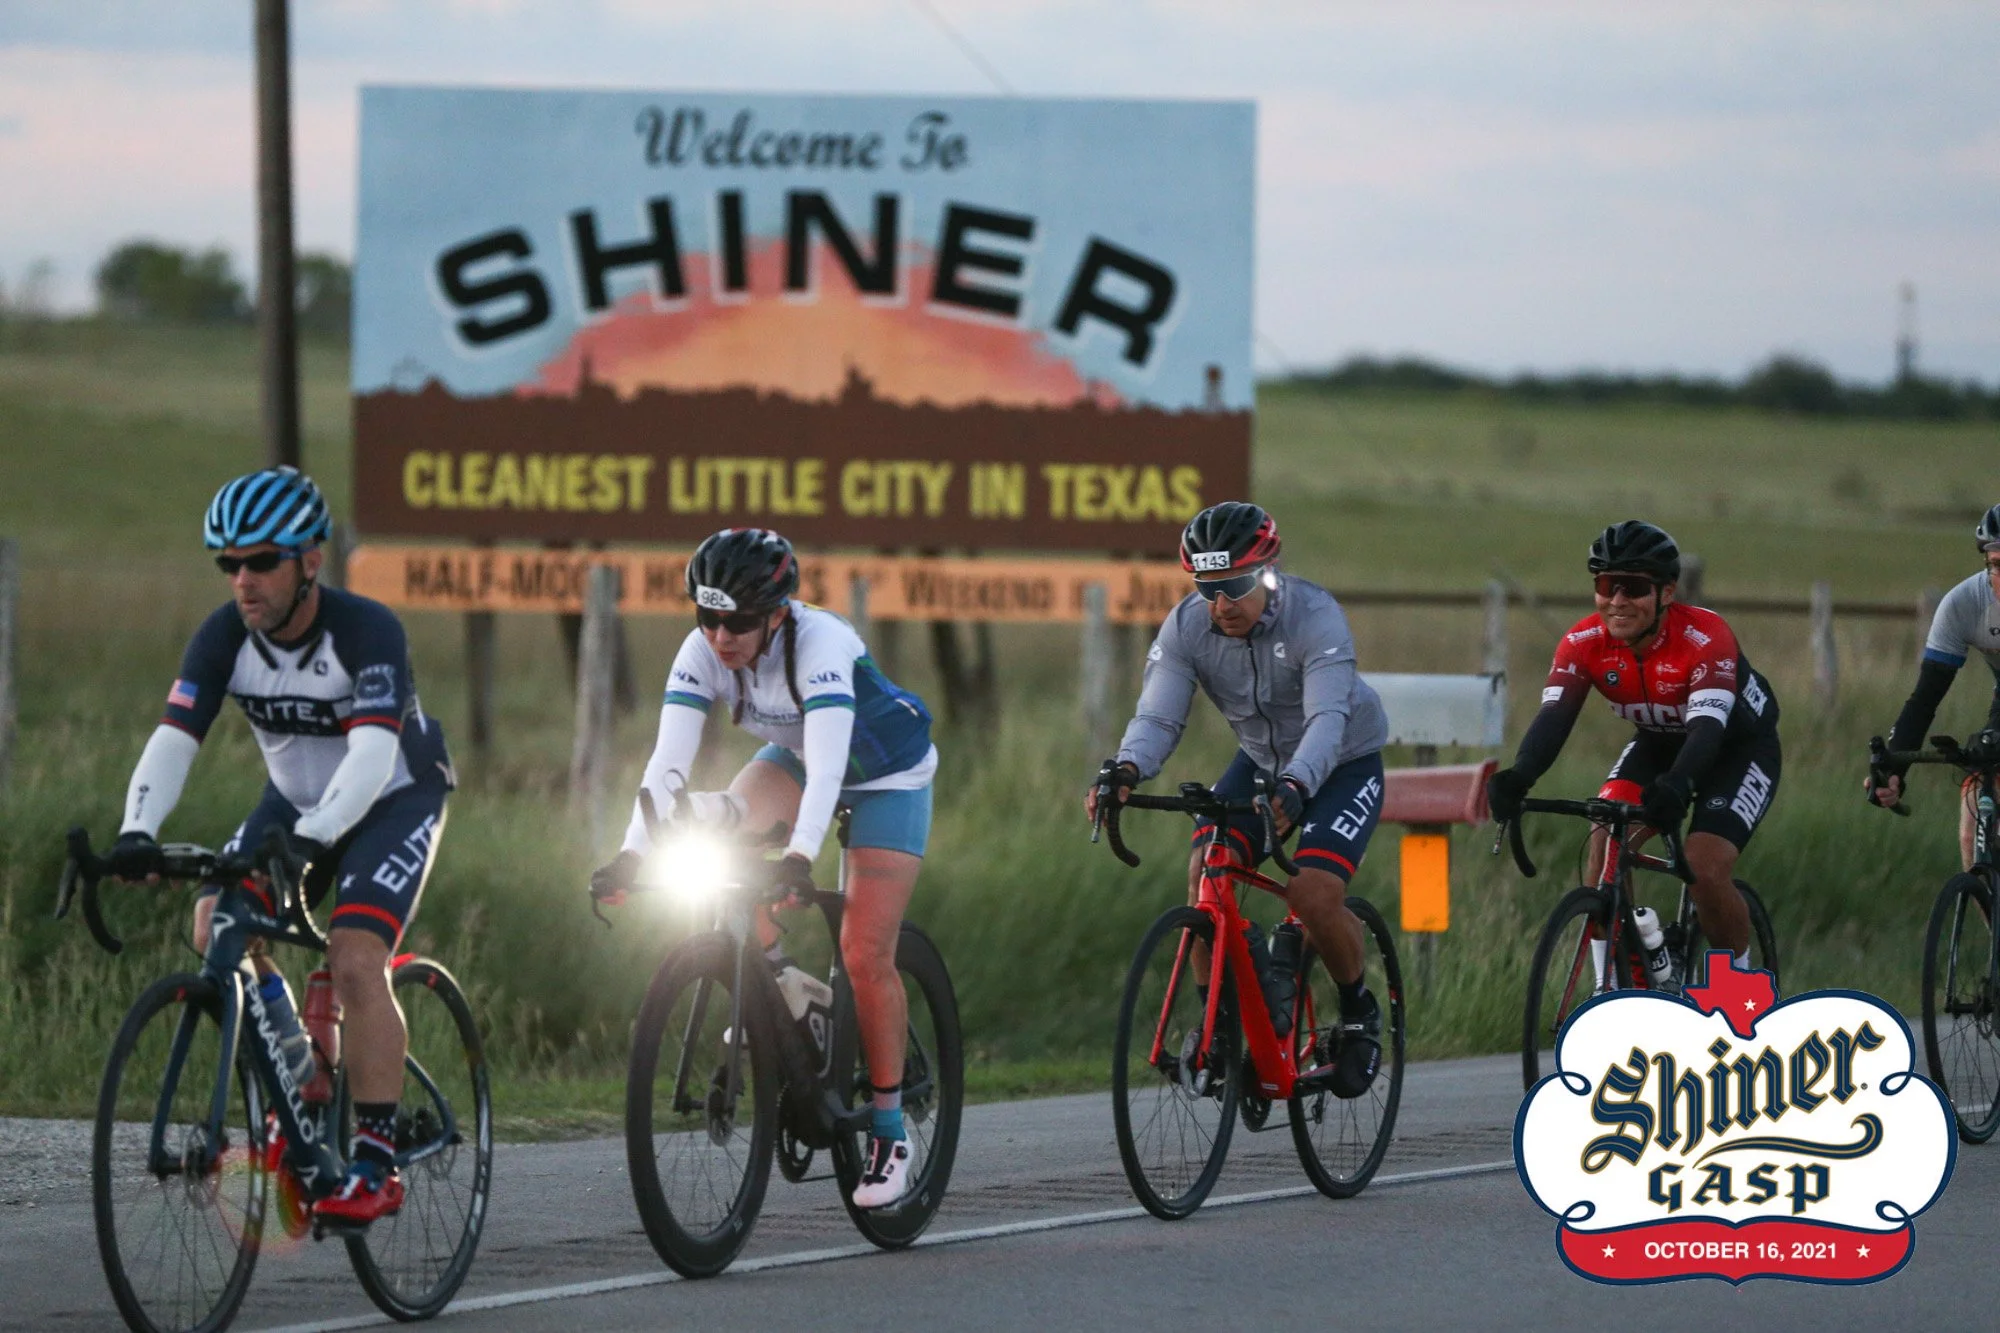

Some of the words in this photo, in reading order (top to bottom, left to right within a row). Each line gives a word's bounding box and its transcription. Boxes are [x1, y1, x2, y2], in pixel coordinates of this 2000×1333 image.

[636, 106, 882, 170] Welcome
[902, 110, 969, 171] To
[436, 189, 1179, 367] SHINER
[403, 451, 653, 511] CLEANEST
[669, 458, 822, 514] LITTLE
[840, 461, 951, 515] CITY
[970, 464, 1025, 517] IN
[1045, 463, 1202, 521] TEXAS
[405, 557, 624, 601] HALF-MOO
[1193, 552, 1229, 570] 1143
[246, 699, 316, 722] LITE
[1610, 702, 1688, 727] OC
[1330, 775, 1382, 842] ELITE
[1730, 760, 1772, 830] ROCK
[245, 980, 315, 1144] PINARELLO
